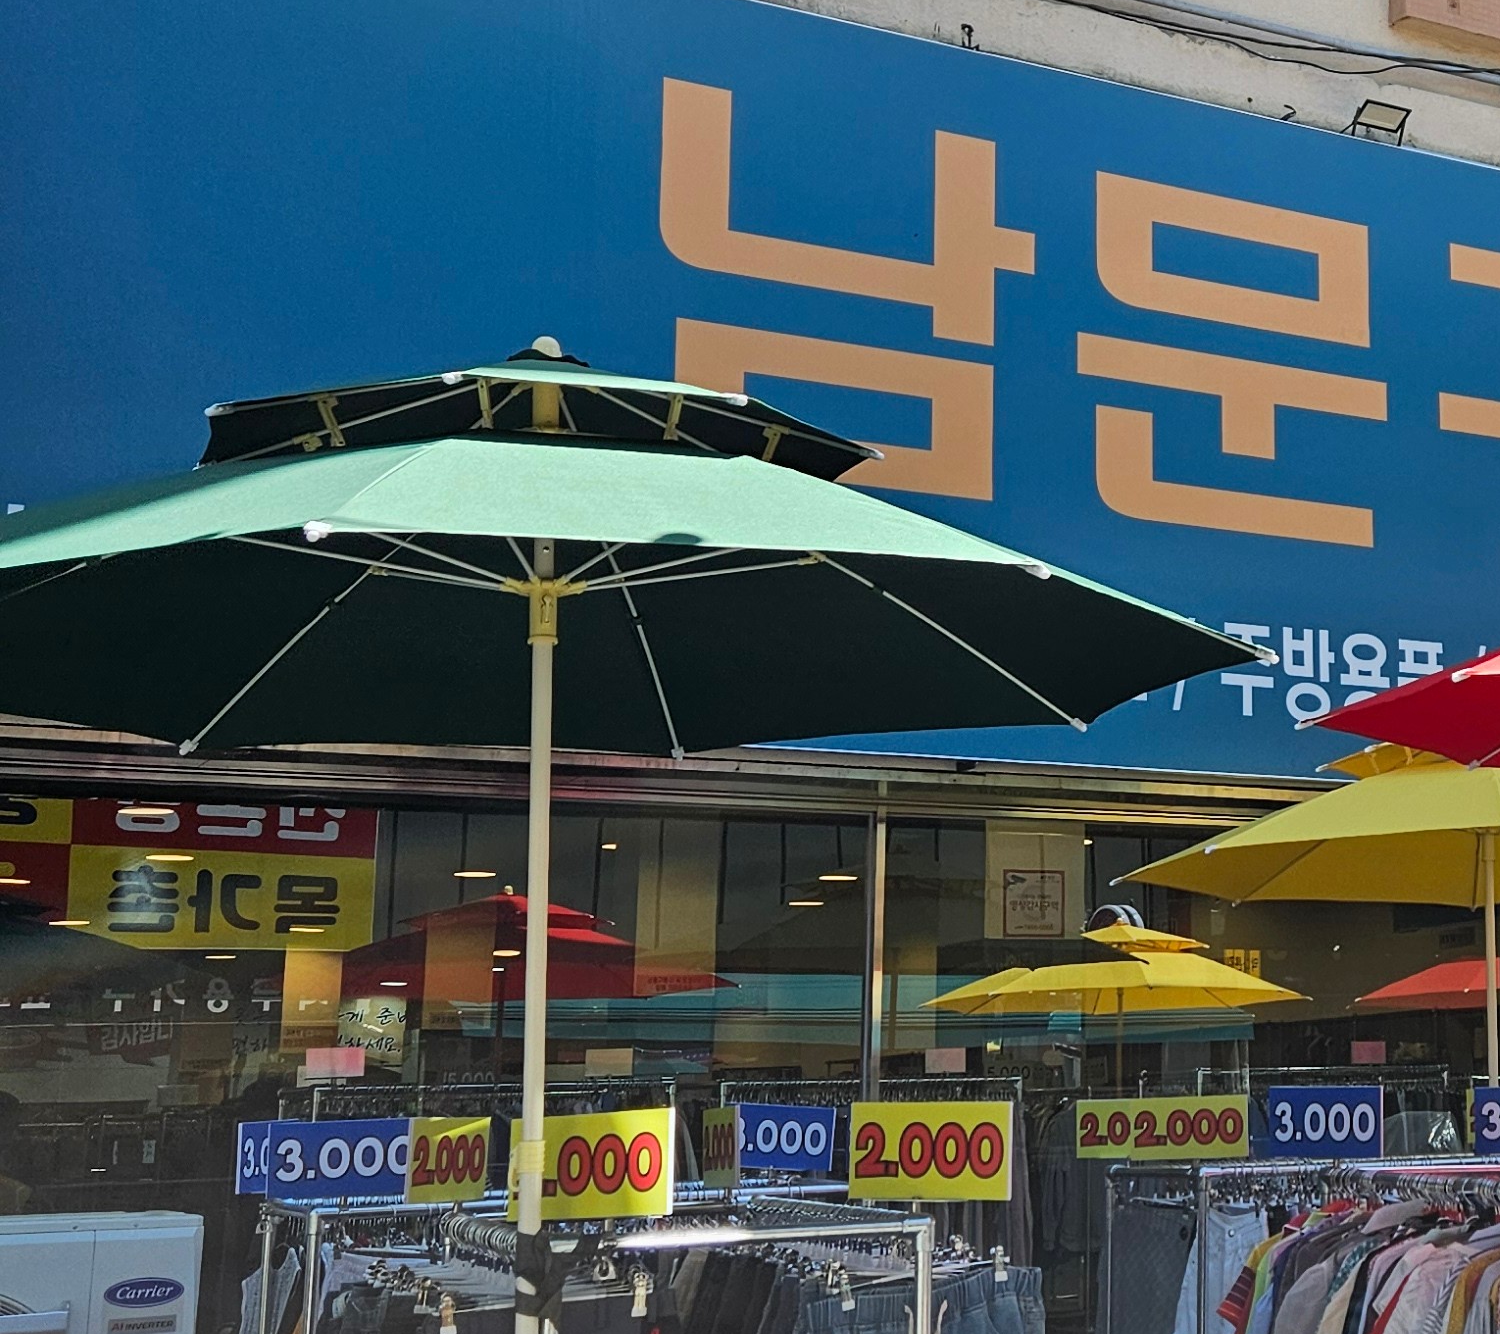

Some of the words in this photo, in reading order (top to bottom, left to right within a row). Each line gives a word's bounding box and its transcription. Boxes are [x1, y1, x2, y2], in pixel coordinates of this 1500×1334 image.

[1133, 1107, 1244, 1148] 2.000
[1274, 1101, 1377, 1143] 3.000
[275, 1136, 408, 1182] 3.000
[411, 1134, 486, 1187] 2.000
[513, 1131, 662, 1201] .000
[854, 1121, 1004, 1180] 2.000
[115, 1283, 174, 1301] Carrier
[125, 1319, 174, 1332] INVERTER
